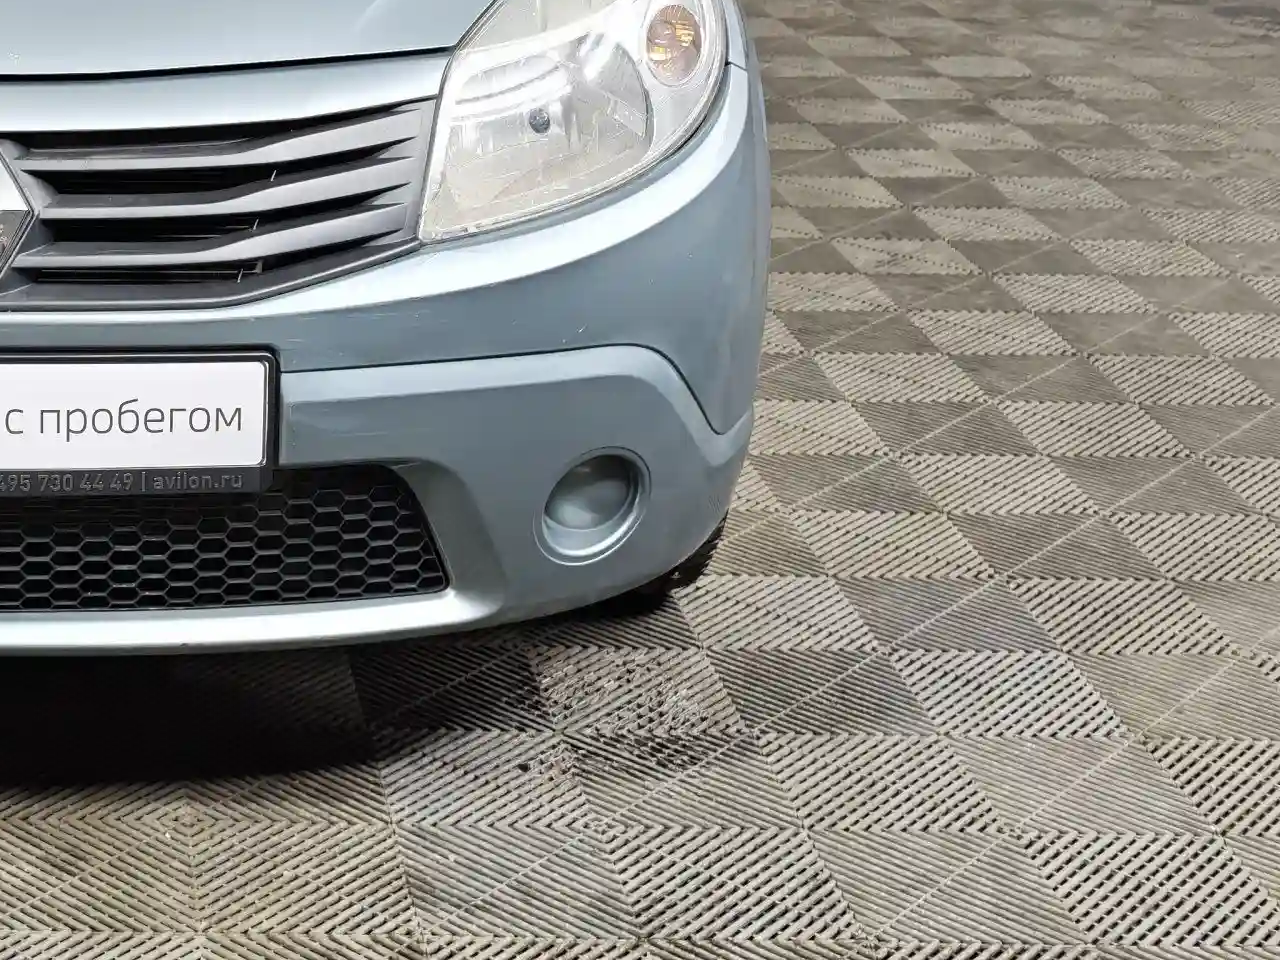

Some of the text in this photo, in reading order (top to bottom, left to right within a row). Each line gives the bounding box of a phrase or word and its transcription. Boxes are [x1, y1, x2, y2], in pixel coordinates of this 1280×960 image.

[5, 408, 24, 435] с
[39, 398, 242, 442] пробегом
[38, 473, 74, 492] 730
[80, 473, 104, 491] 44
[109, 471, 134, 491] 49
[152, 470, 243, 490] avilon.ru
